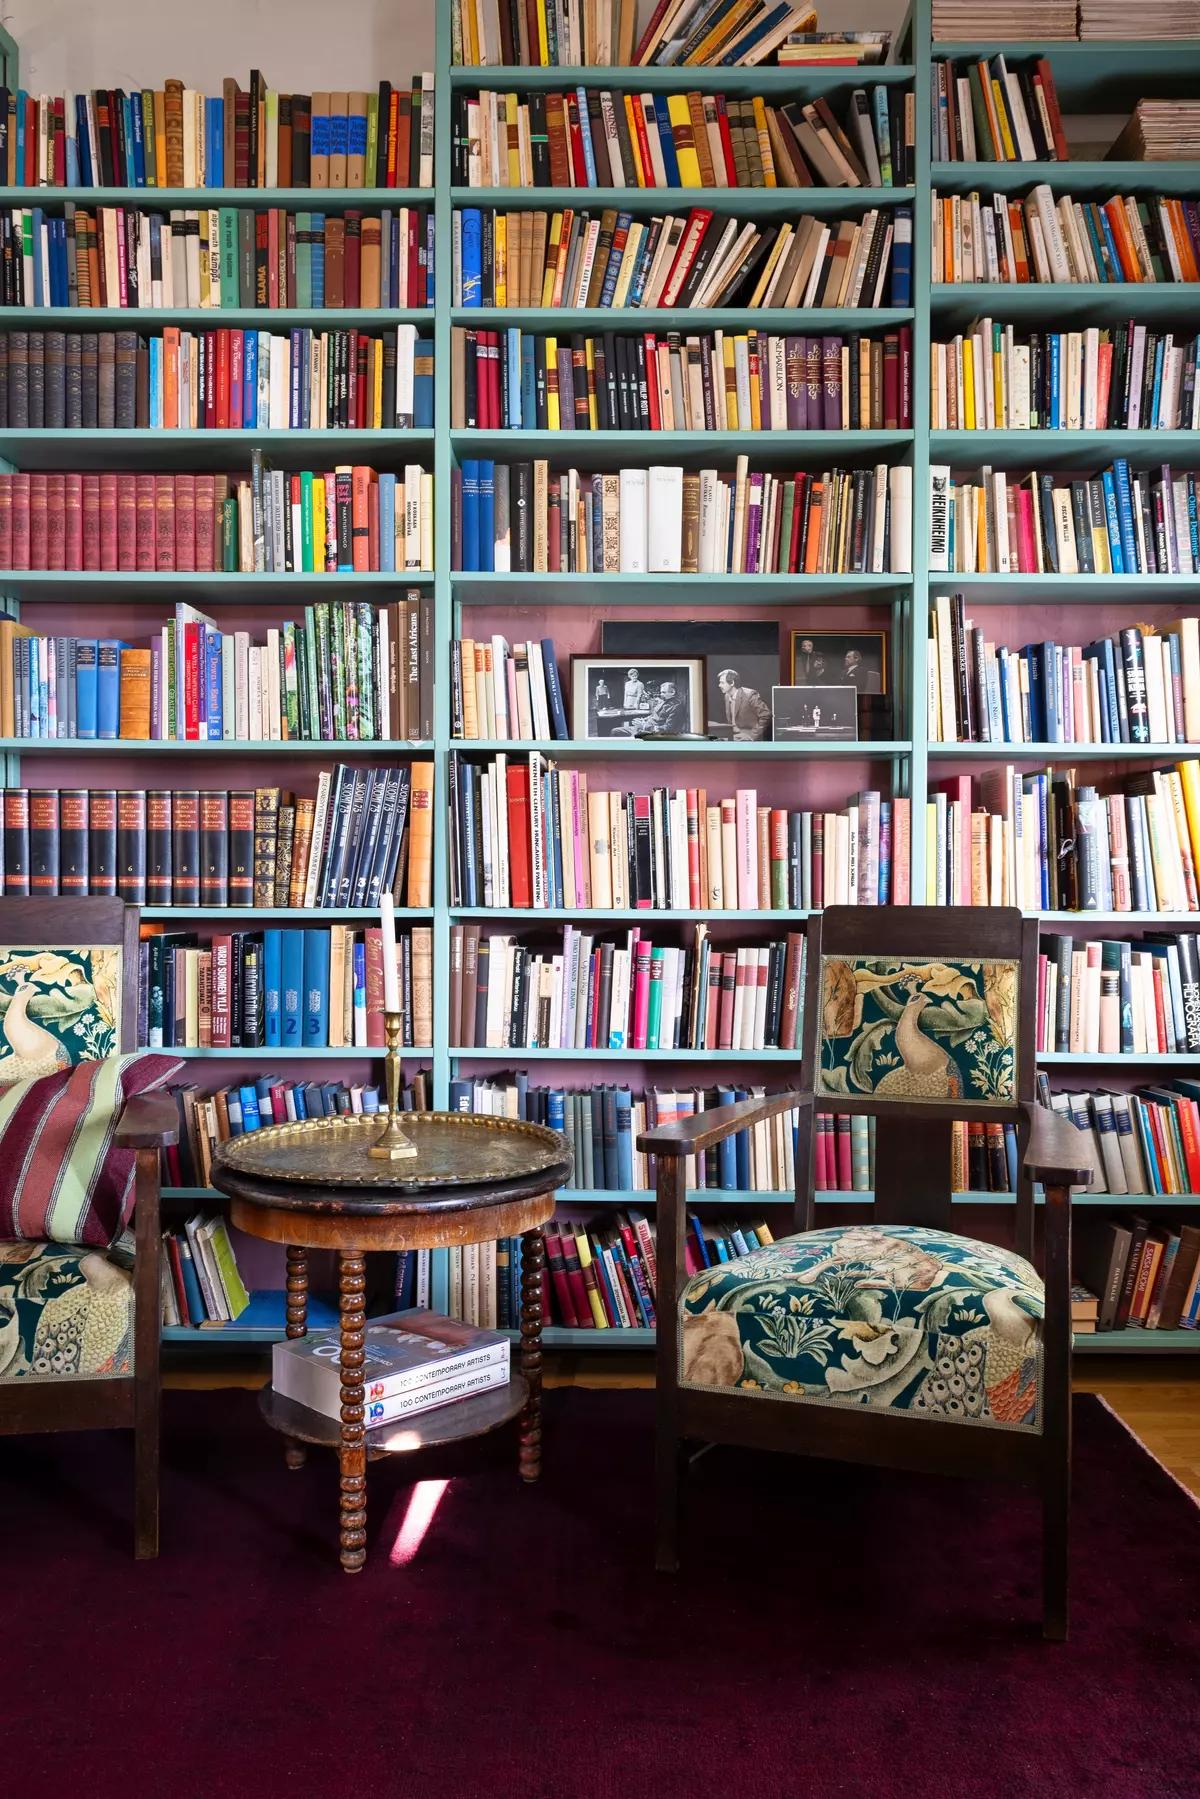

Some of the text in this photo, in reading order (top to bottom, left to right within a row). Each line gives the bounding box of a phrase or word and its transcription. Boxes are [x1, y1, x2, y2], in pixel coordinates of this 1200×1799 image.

[257, 265, 266, 304] SALAMA
[775, 341, 783, 391] SILMARILLION
[1092, 485, 1100, 508] HENRY
[932, 494, 946, 553] HEIKINHEIMO
[1188, 495, 1200, 556] Other Destinies
[409, 613, 418, 683] The Last Africans
[340, 782, 353, 813] SUOMI 75
[353, 782, 367, 813] SUOMI 75
[370, 782, 385, 813] SUOMI 75
[384, 781, 398, 812] SUOMI 75
[397, 783, 408, 813] SUOMI 75
[218, 945, 226, 965] VARJO
[368, 936, 383, 995] Eino Leino
[218, 967, 226, 995] SUOMEN
[245, 968, 257, 1014] NÄKYMÄTÖN
[218, 996, 227, 1013] YLLÄ
[1183, 983, 1198, 1048] FILMOGRAFIA
[270, 1018, 277, 1034] 1
[285, 1019, 297, 1034] 2
[309, 1018, 320, 1035] 3
[614, 1289, 624, 1315] HERMITAGE
[414, 1362, 465, 1383] CONTEMPORARY
[467, 1353, 491, 1367] ARTISTS
[400, 1374, 491, 1409] 100 CONTEMPORARY ARTISTS
